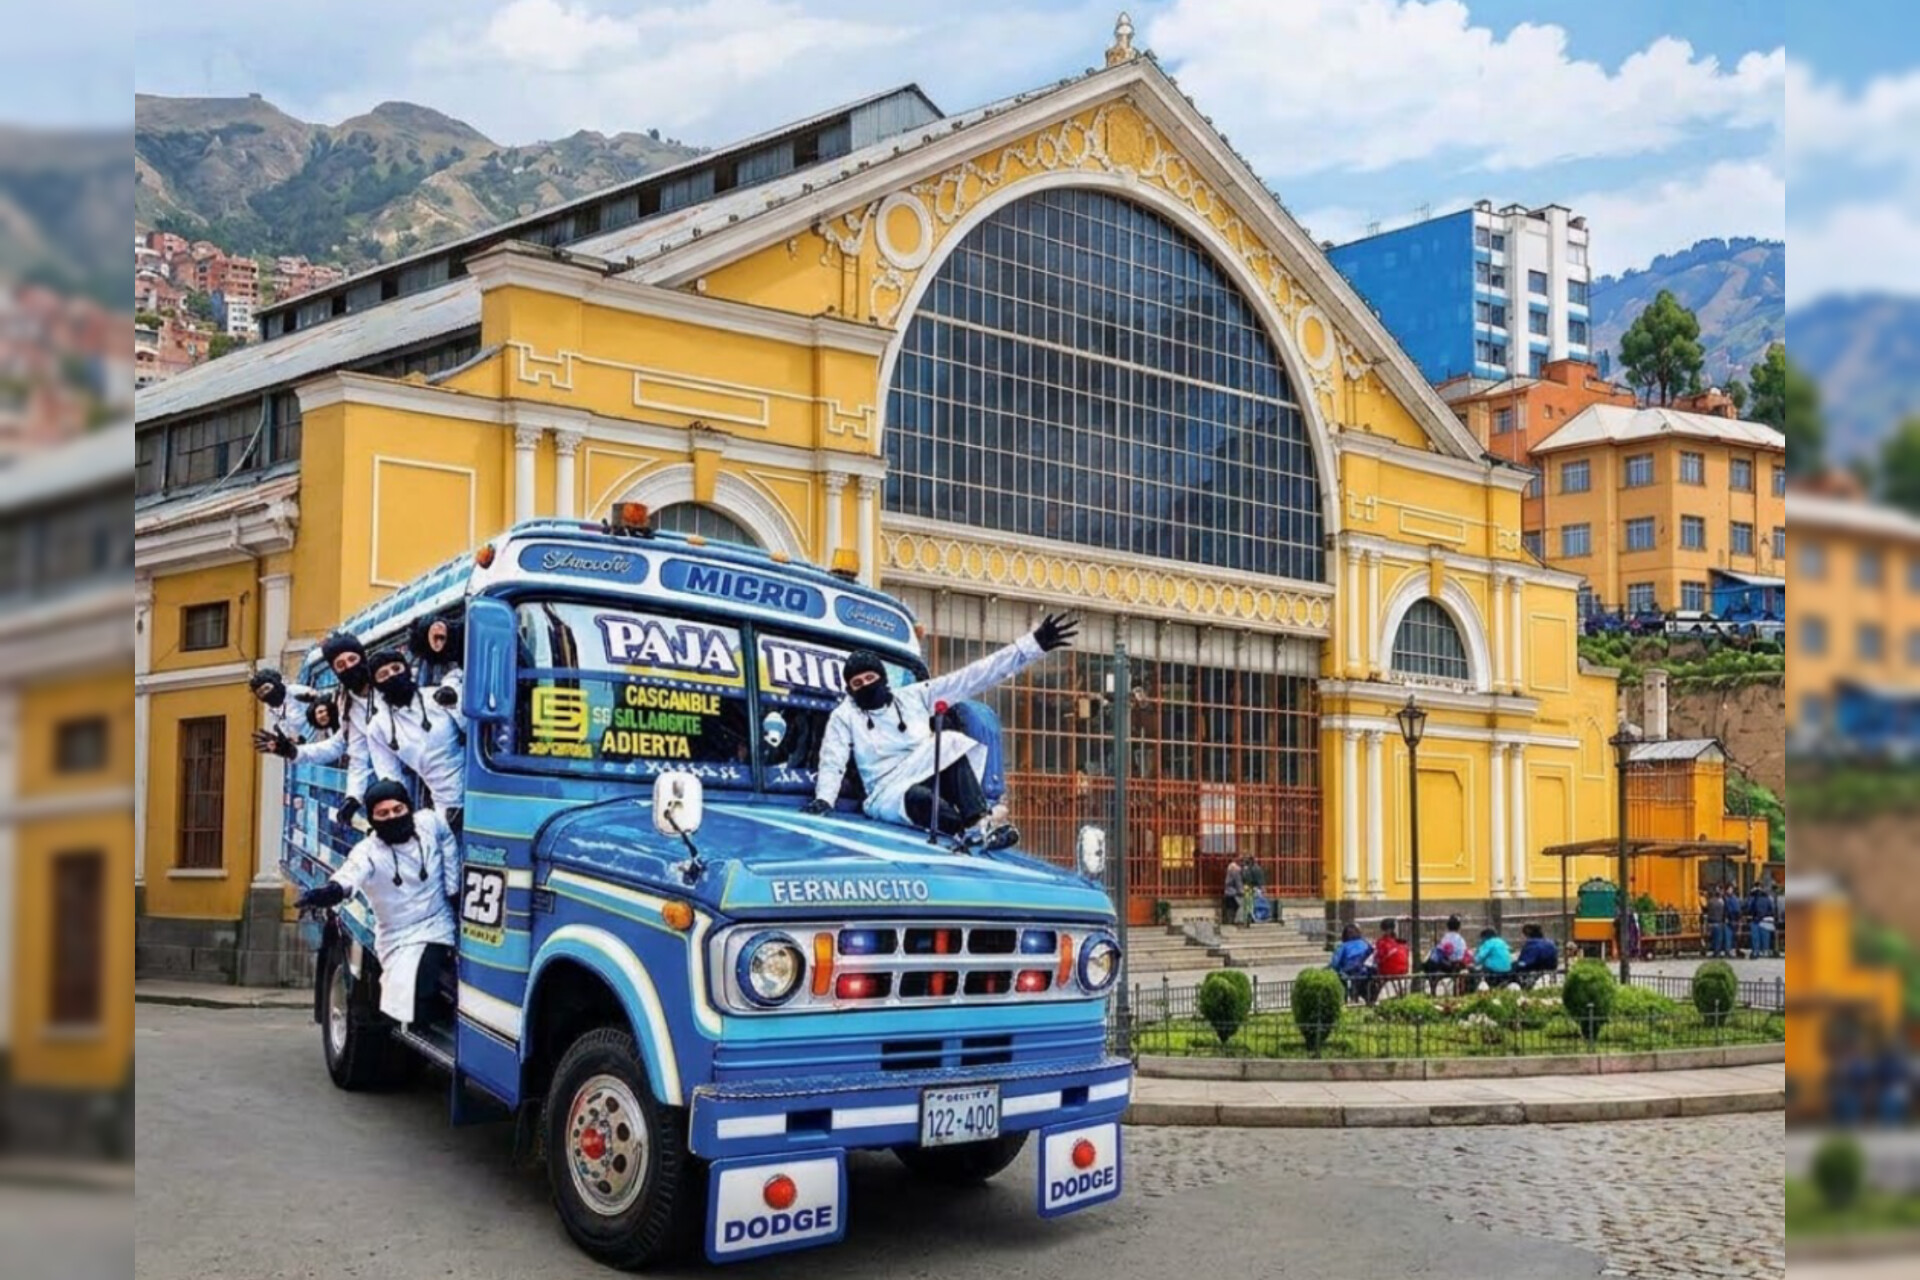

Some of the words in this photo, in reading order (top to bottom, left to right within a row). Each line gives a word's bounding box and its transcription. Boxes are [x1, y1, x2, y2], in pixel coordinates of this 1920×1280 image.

[686, 565, 809, 612] MICRO
[596, 616, 739, 676] PAJA
[601, 730, 691, 758] ADIERTA
[463, 871, 503, 924] 23
[772, 879, 929, 902] FERNANCITO
[1051, 1166, 1114, 1202] DODGE
[724, 1205, 832, 1244] DODGE
